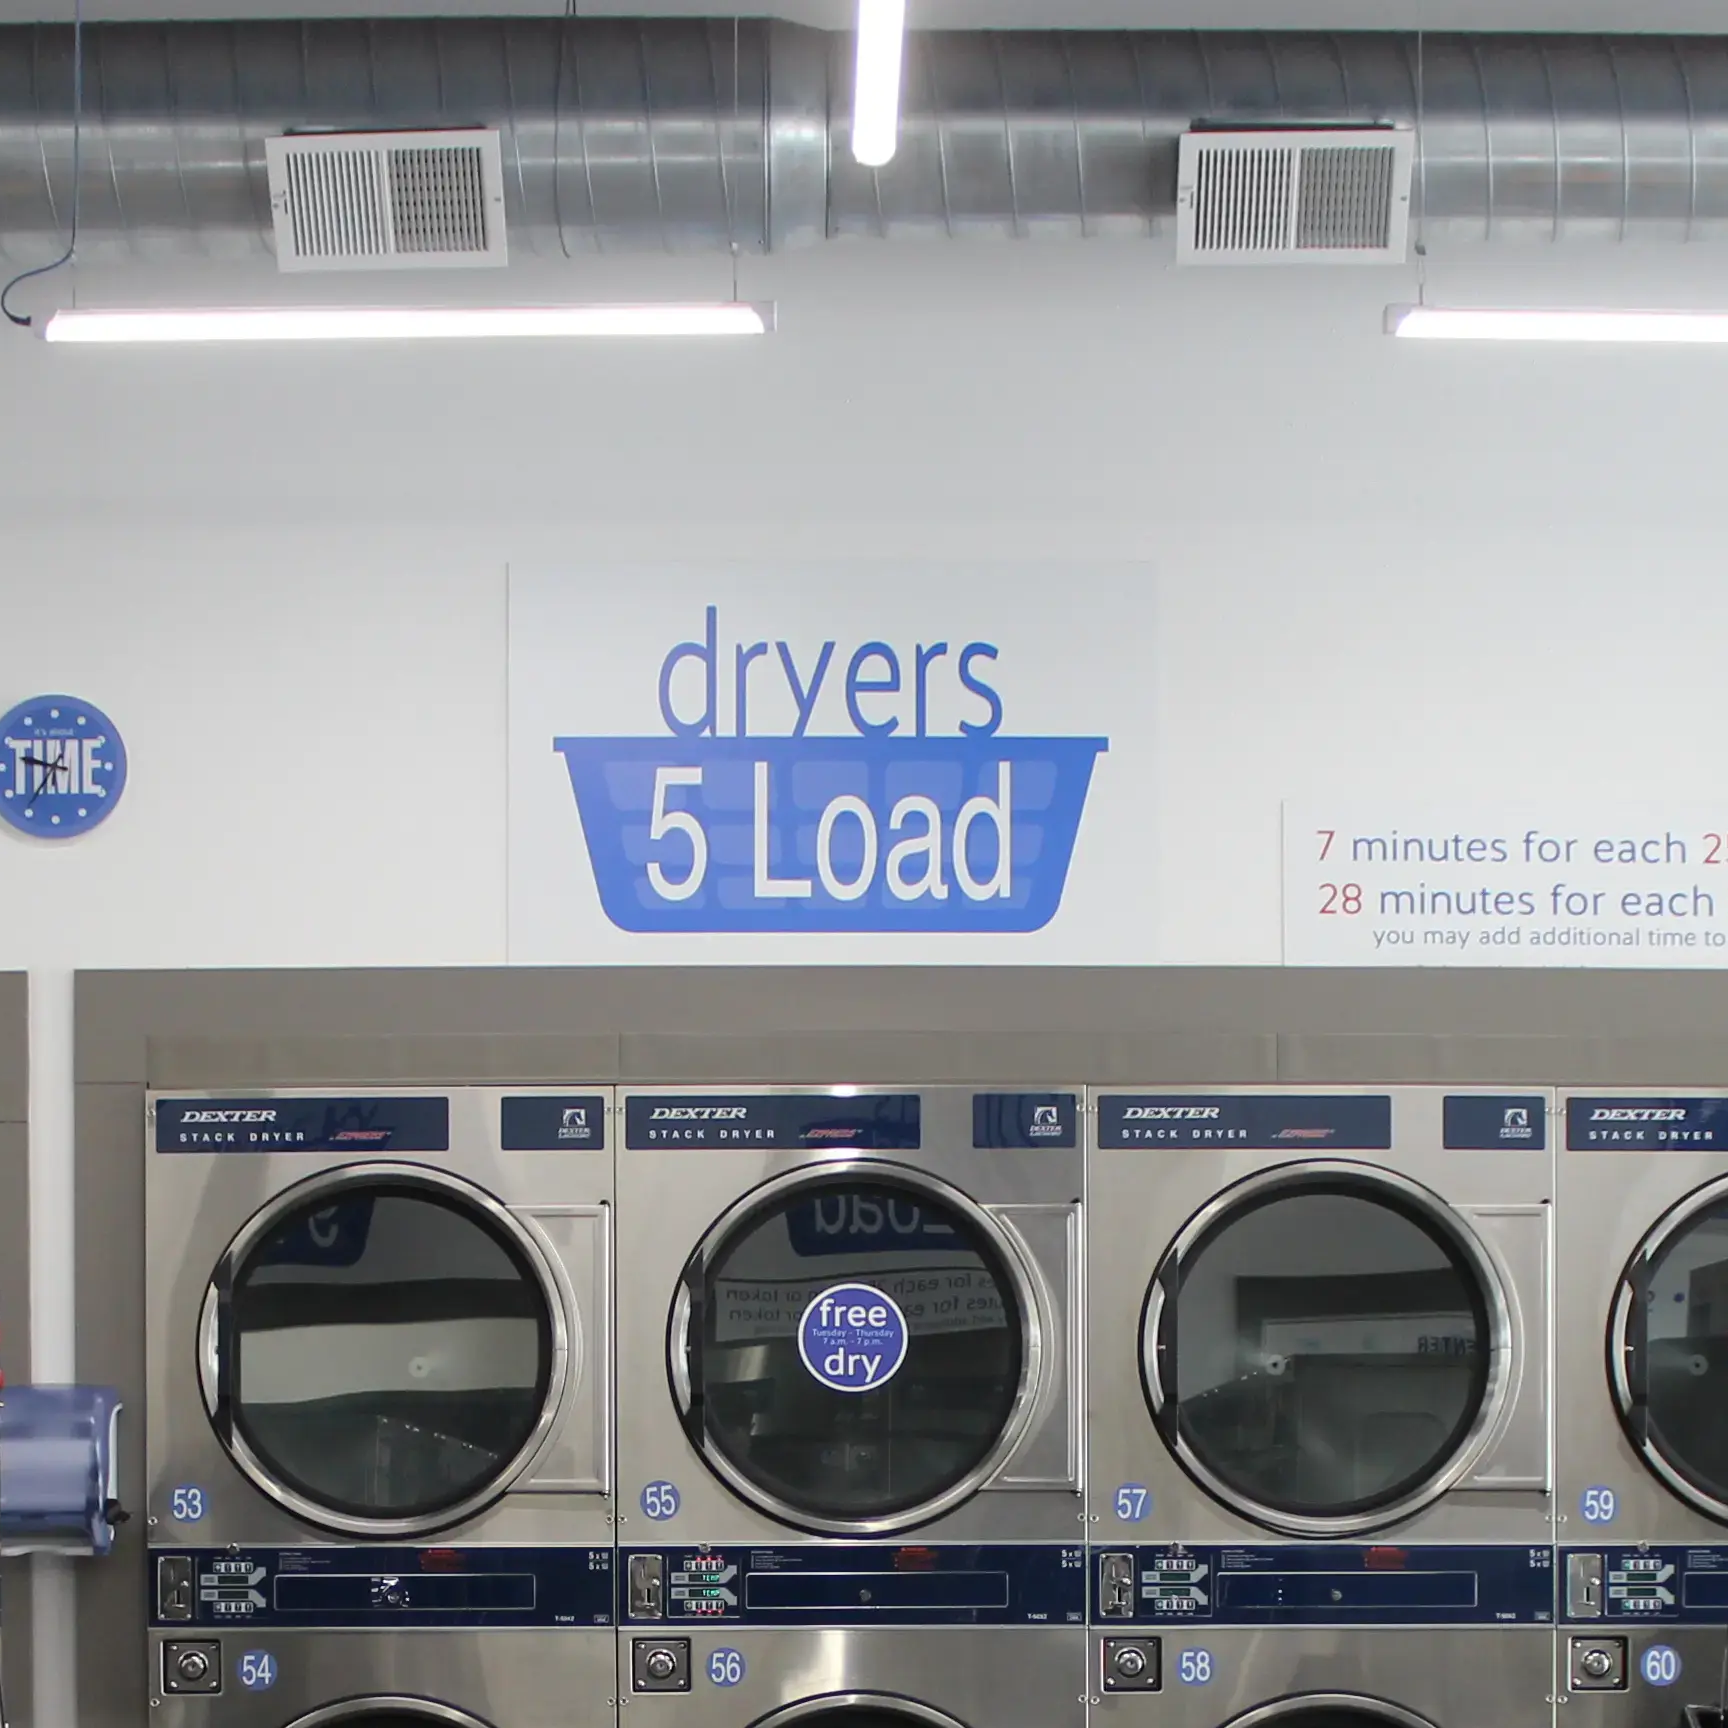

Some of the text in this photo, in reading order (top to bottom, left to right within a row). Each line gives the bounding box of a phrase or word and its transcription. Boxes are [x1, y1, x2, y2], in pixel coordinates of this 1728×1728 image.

[658, 604, 1004, 737] dryers
[8, 738, 102, 795] TIME
[646, 760, 1011, 901] 5 Load
[1316, 830, 1335, 862] 7
[1352, 831, 1508, 864] minutes
[1522, 830, 1578, 865] for
[1593, 831, 1688, 865] each
[1318, 883, 1362, 915] 28
[1379, 884, 1536, 917] minutes
[1550, 883, 1605, 917] for
[1621, 885, 1715, 918] each
[1373, 927, 1415, 950] you
[1423, 929, 1471, 951] may
[1479, 925, 1521, 946] add
[1529, 926, 1641, 947] additional
[1648, 926, 1698, 947] time
[1704, 929, 1728, 948] to
[180, 1110, 277, 1123] DEXTER
[649, 1107, 747, 1120] DEXTER
[1122, 1107, 1220, 1120] DEXTER
[1589, 1108, 1687, 1121] DEXTER
[180, 1131, 304, 1142] STACK DRYER
[649, 1129, 775, 1139] STACK DRYER
[1122, 1129, 1248, 1139] STACK DRYER
[1589, 1130, 1713, 1140] STACK DRYER
[820, 1299, 887, 1327] free
[812, 1329, 846, 1339] Tuesday
[856, 1329, 894, 1339] Thursday
[824, 1348, 882, 1382] dry
[172, 1488, 202, 1519] 53
[646, 1485, 675, 1516] 55
[1117, 1488, 1147, 1519] 57
[1584, 1490, 1614, 1520] 59
[241, 1655, 272, 1685] 54
[710, 1652, 741, 1682] 56
[1180, 1652, 1211, 1682] 58
[1646, 1650, 1675, 1680] 60
